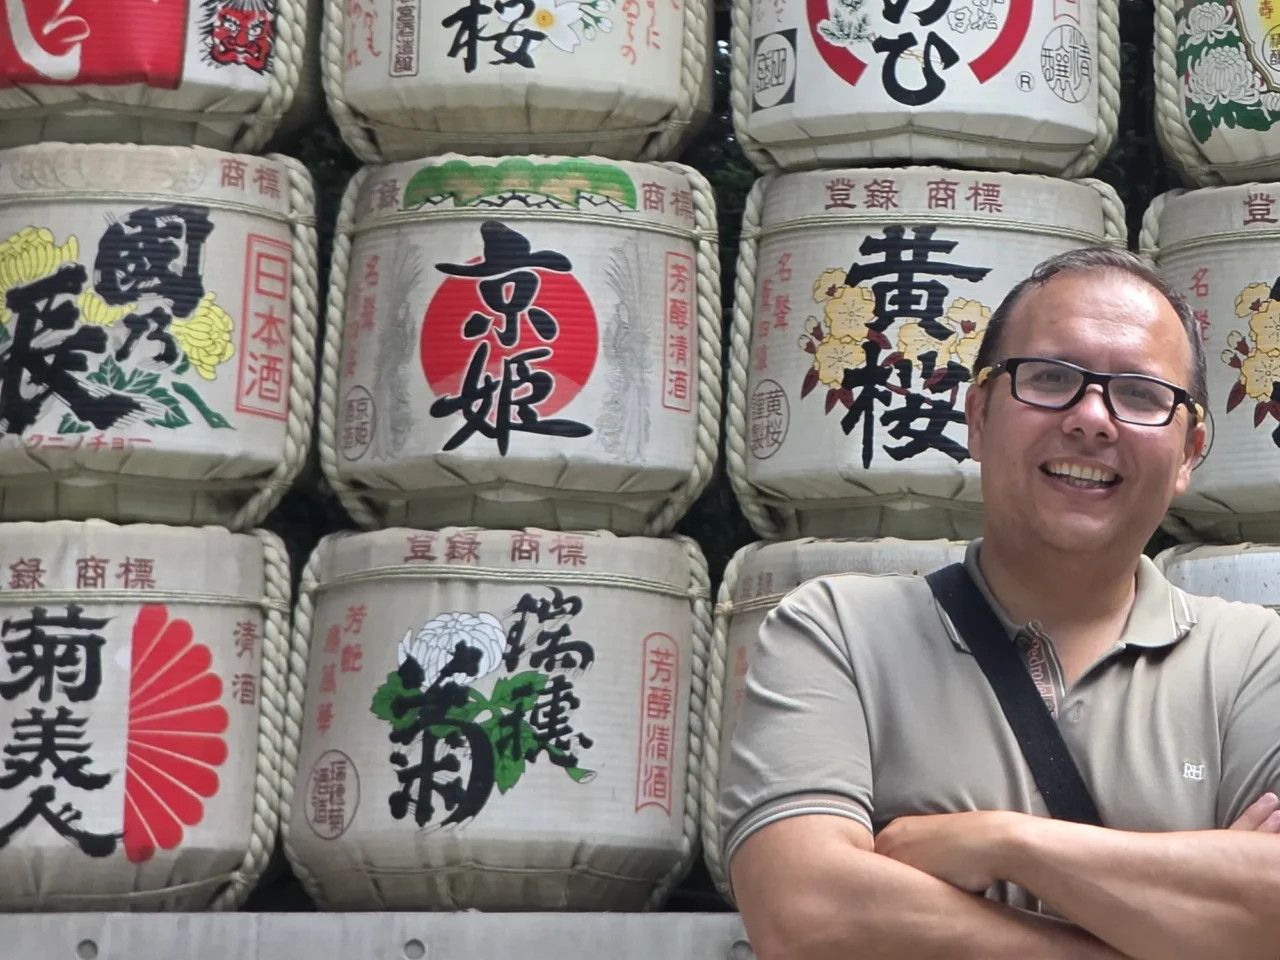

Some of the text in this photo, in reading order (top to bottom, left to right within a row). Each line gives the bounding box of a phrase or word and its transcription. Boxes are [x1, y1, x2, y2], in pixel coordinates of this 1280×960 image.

[824, 177, 1004, 213] 登録商標
[246, 252, 289, 403] 日本酒
[430, 220, 594, 457] 京姫
[0, 603, 128, 858] 菊美人
